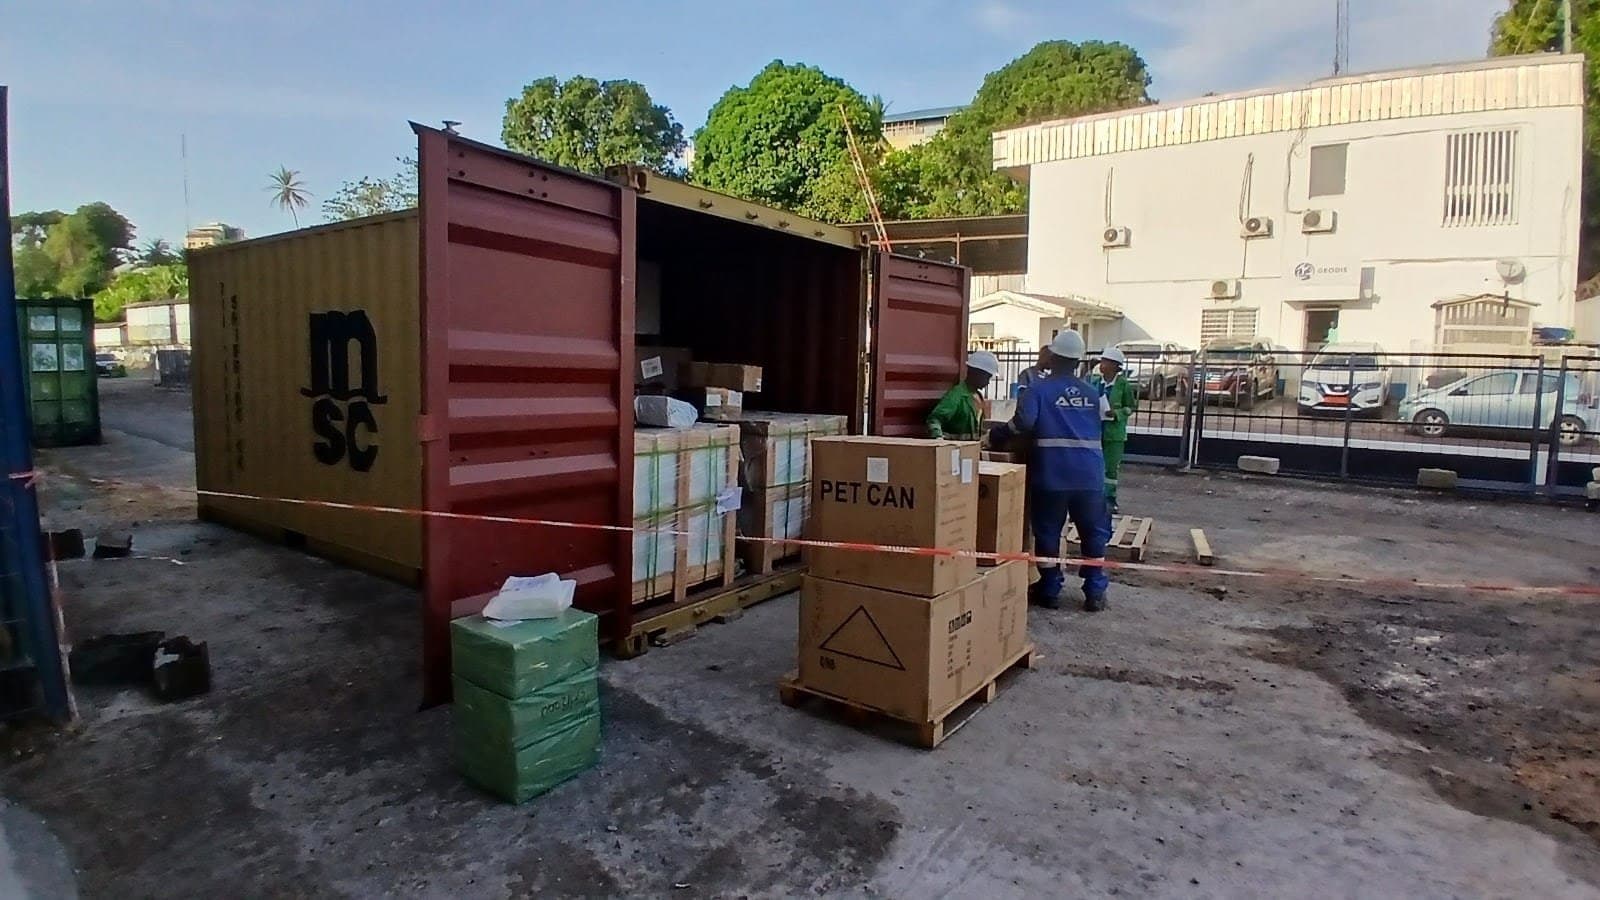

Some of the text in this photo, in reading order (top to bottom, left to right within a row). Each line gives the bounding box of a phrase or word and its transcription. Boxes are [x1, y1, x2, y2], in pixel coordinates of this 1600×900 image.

[1055, 396, 1095, 407] AGL
[820, 479, 915, 509] PET CAN
